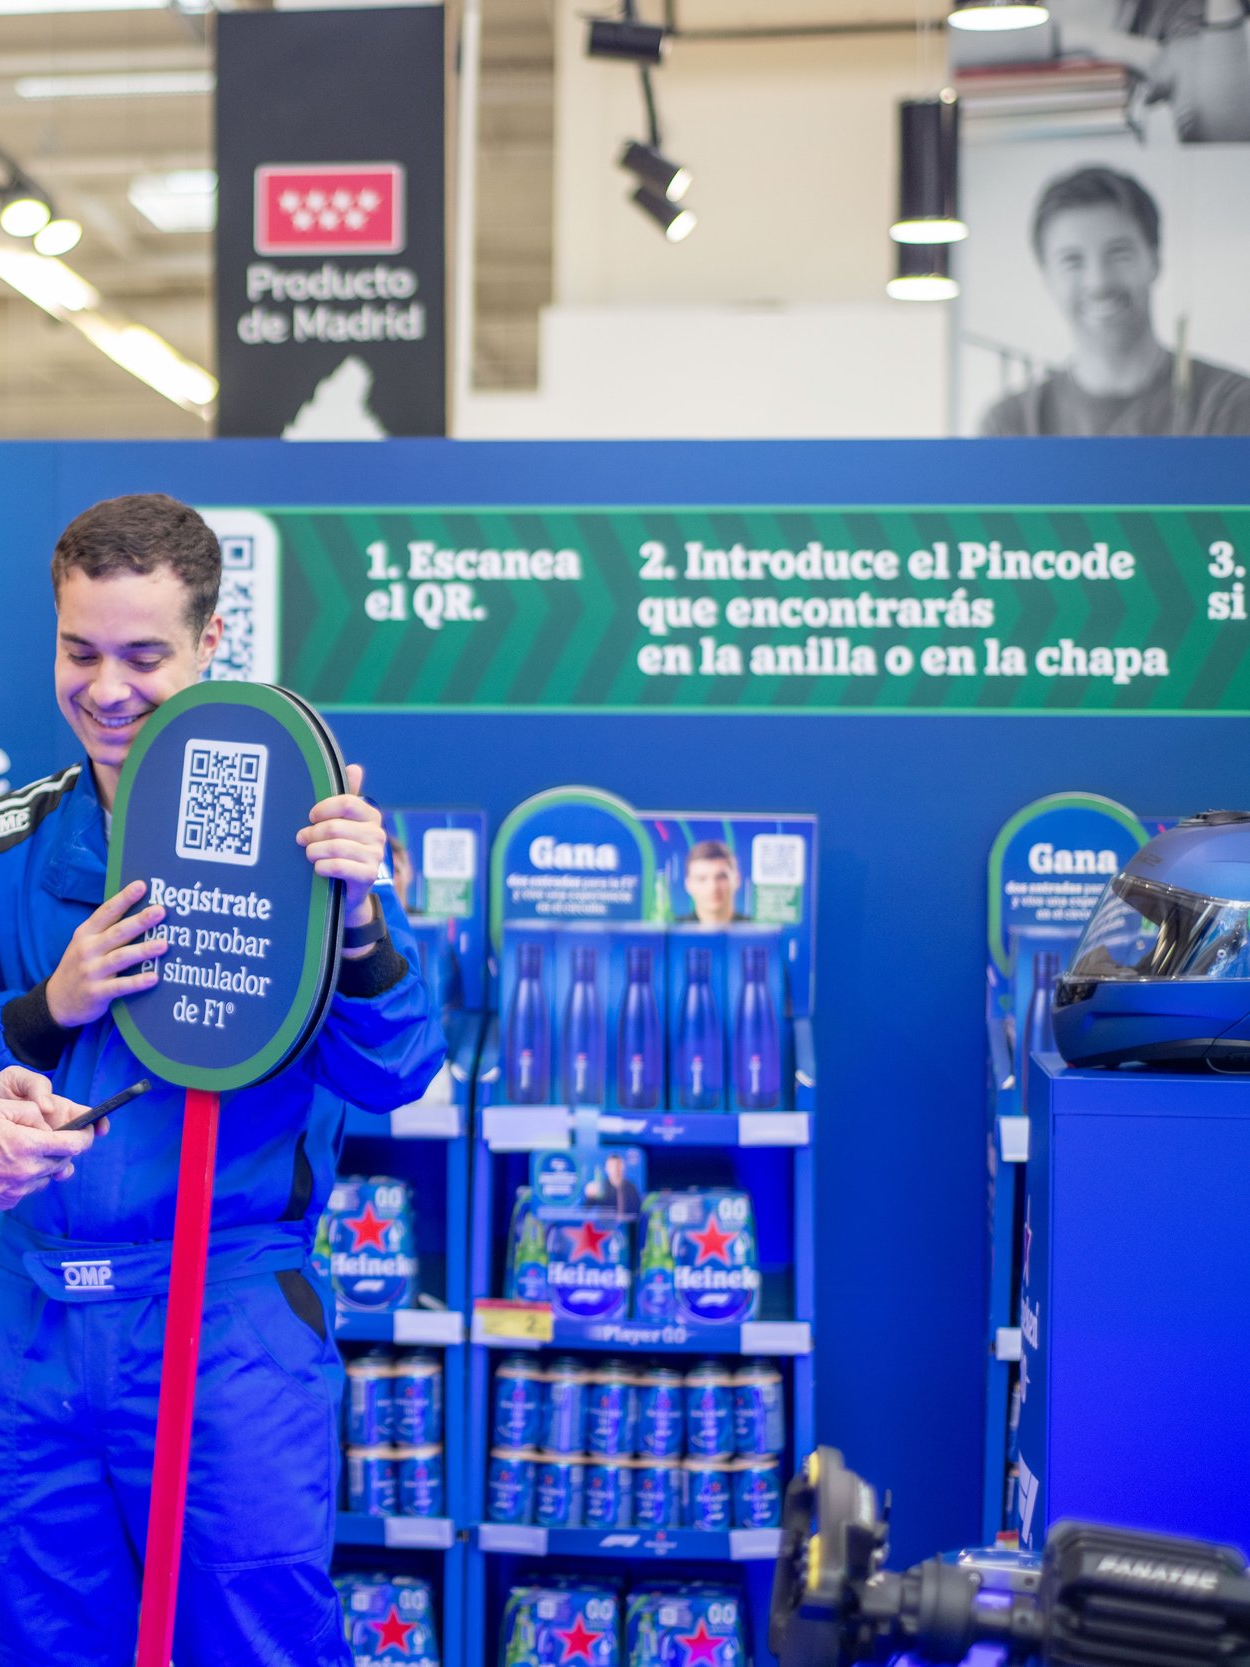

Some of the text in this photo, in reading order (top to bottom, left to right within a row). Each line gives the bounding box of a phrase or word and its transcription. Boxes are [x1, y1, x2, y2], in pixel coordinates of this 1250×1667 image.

[247, 262, 417, 301] Producto
[238, 303, 425, 344] de Madrid
[366, 540, 582, 580] 1. Escanea
[639, 541, 1135, 580] 2. Introduce el Pincode
[1208, 540, 1246, 578] 3.
[365, 582, 487, 629] el QR.
[638, 588, 994, 636] que encontrarás
[1208, 582, 1247, 620] si
[637, 636, 1169, 684] en la anilla o en la chapa
[529, 835, 618, 870] Gana
[1029, 842, 1118, 874] Gana
[149, 878, 271, 919] Regístrate
[194, 927, 270, 957] probar
[163, 957, 270, 996] simulador
[173, 995, 198, 1023] de
[63, 1264, 113, 1287] OMP
